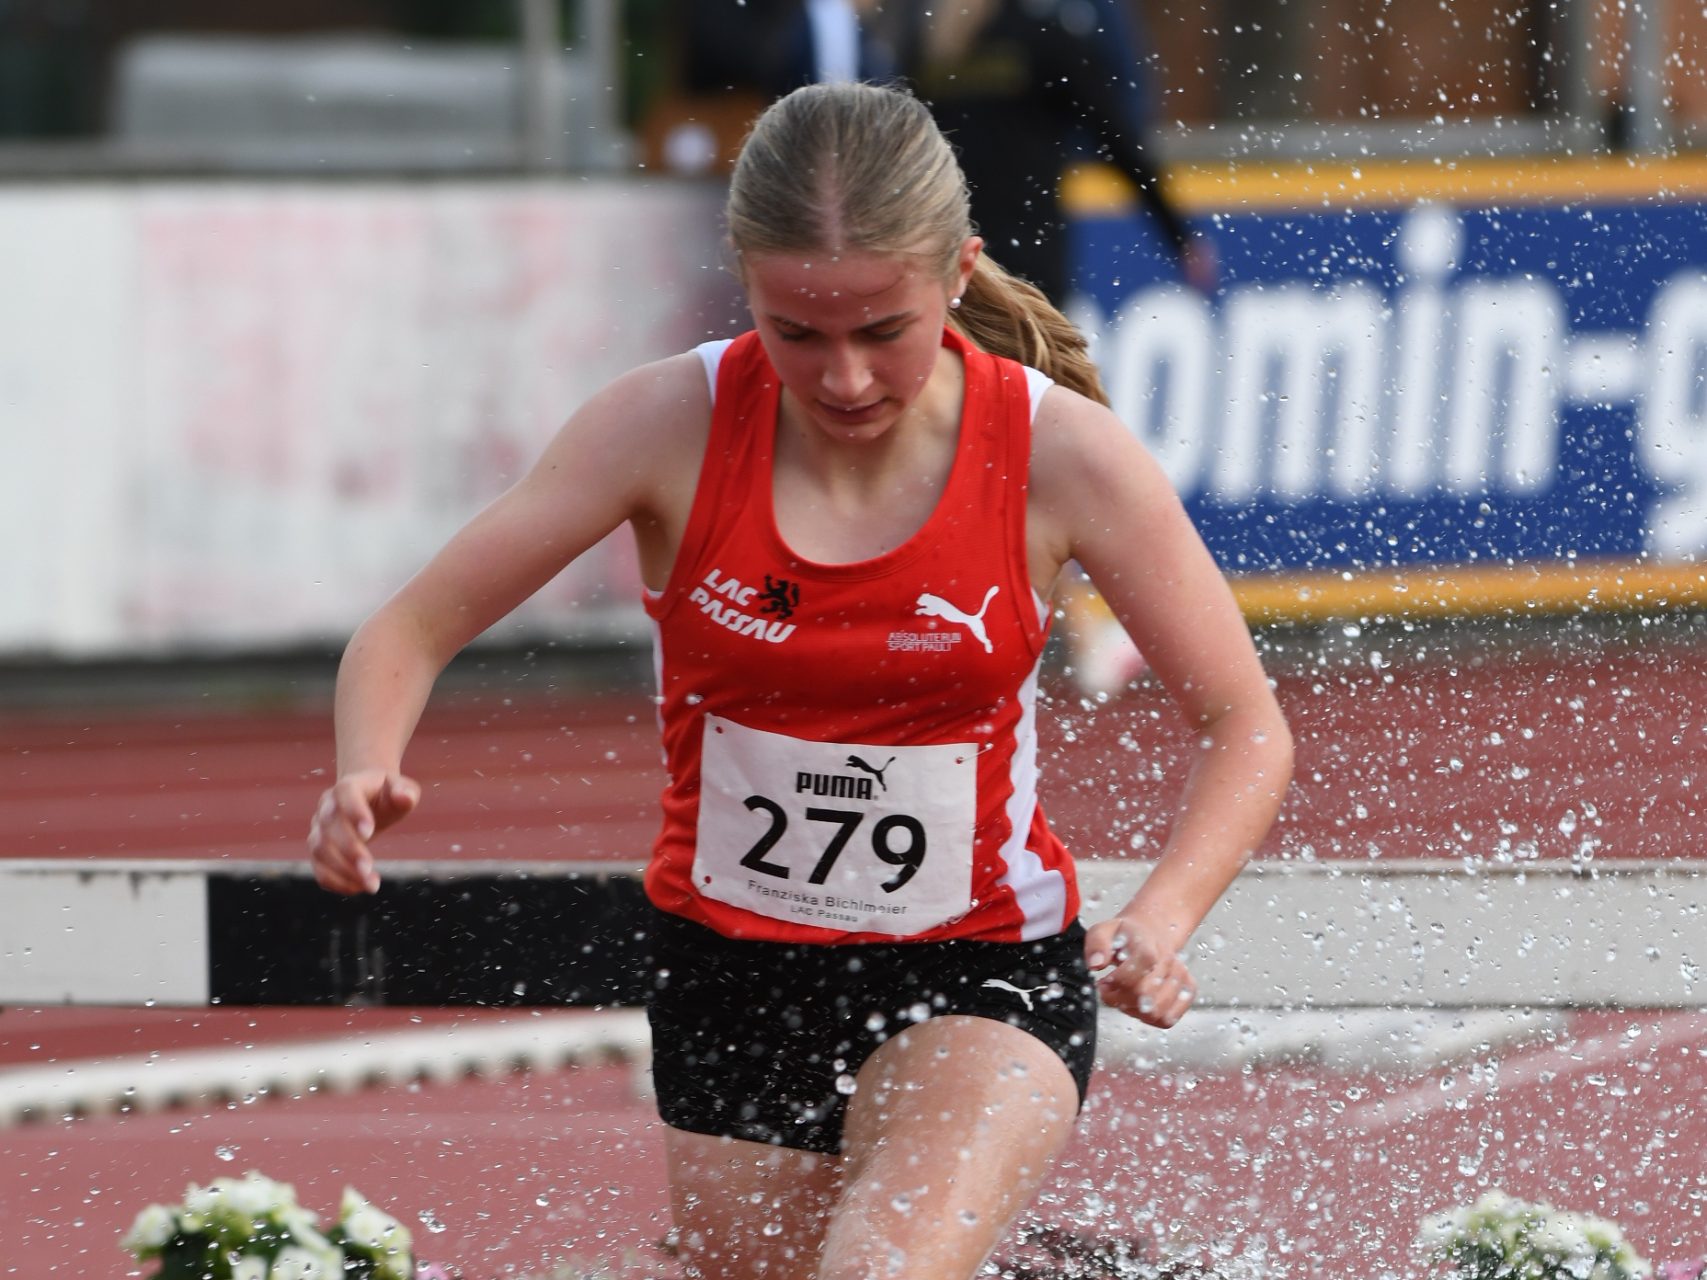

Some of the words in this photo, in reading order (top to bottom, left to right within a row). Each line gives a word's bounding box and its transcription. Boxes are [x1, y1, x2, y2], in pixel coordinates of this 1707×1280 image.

[704, 569, 756, 606] LAC
[689, 588, 796, 643] PASSAU
[796, 772, 871, 800] PUMA
[739, 795, 927, 893] 279
[748, 880, 818, 905] Franziska
[824, 896, 908, 914] Bichlmeier
[791, 905, 813, 916] LAC
[817, 909, 858, 922] Passau
